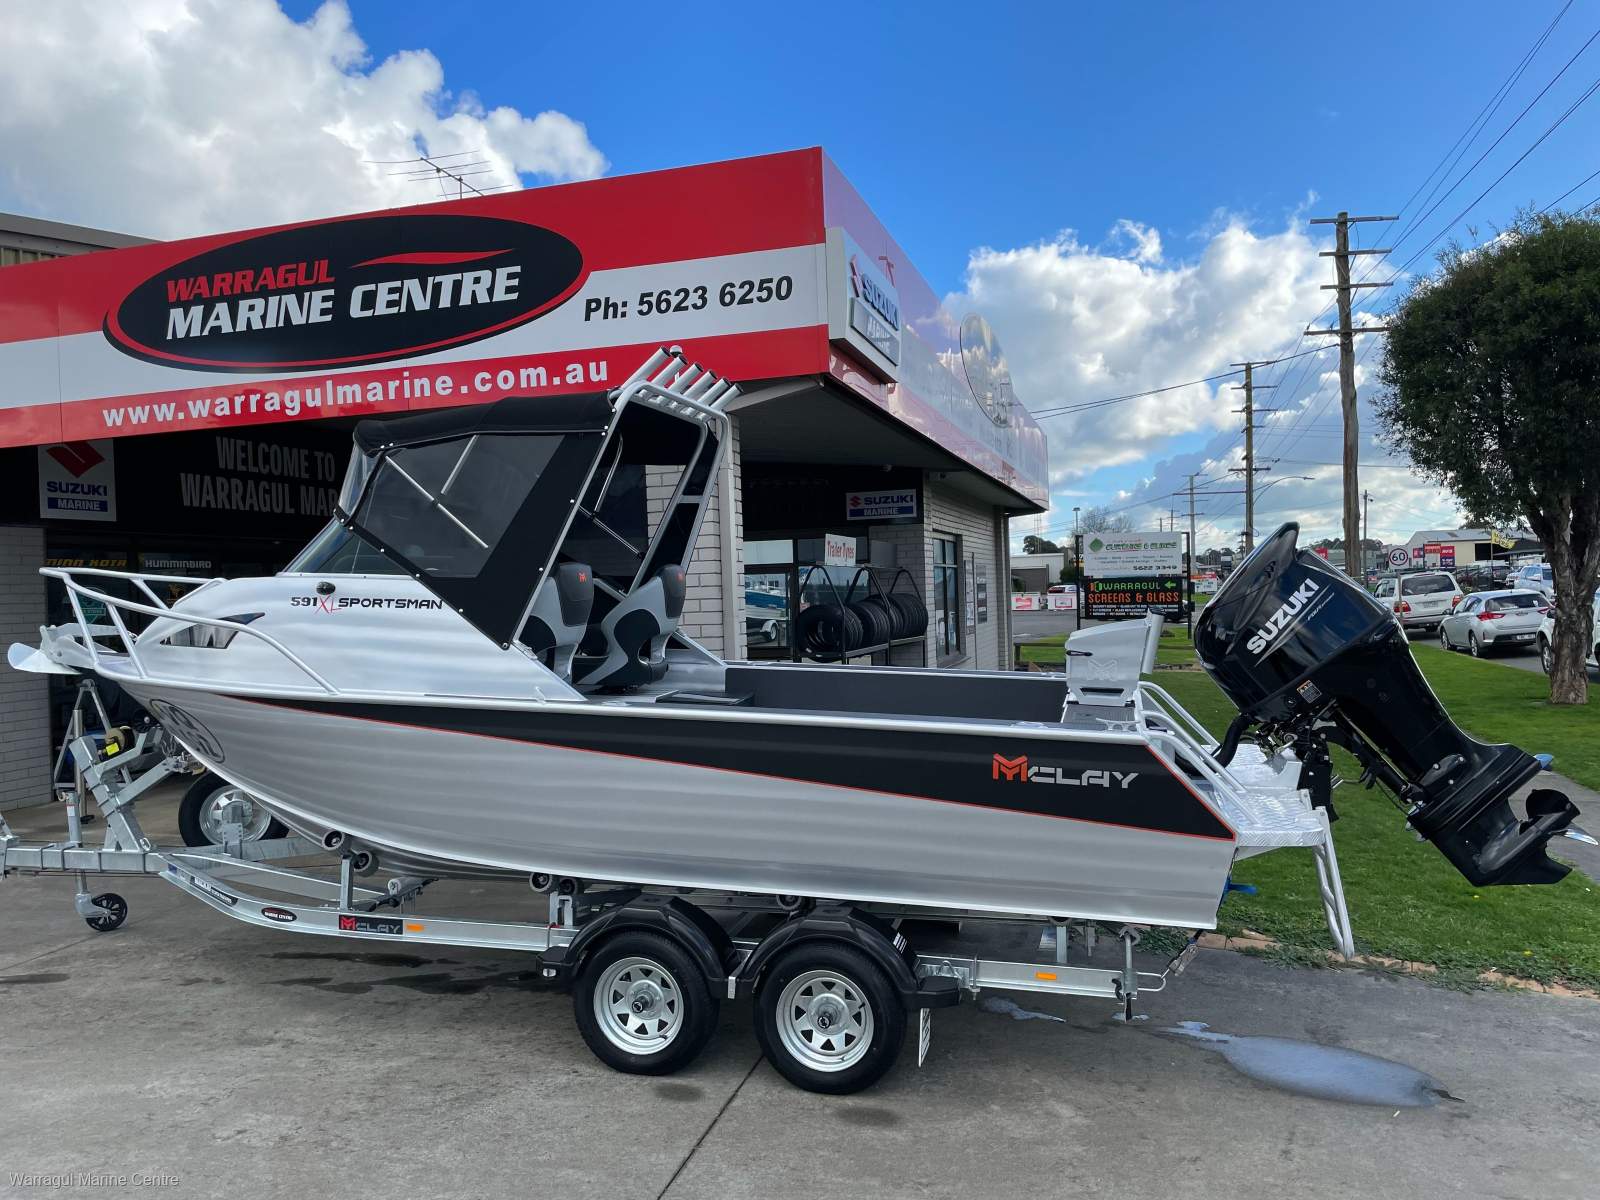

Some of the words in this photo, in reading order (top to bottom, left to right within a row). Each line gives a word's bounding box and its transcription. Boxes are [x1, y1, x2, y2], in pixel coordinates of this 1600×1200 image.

[166, 259, 336, 303] WARRAGUL
[166, 288, 335, 340] MARINE
[349, 265, 522, 319] CENTRE
[584, 296, 629, 322] Ph:
[636, 285, 708, 317] 5623
[718, 275, 794, 308] 6250
[860, 273, 899, 332] SUZUKI
[103, 360, 608, 427] www.warragulmarine.com.au
[215, 436, 310, 479] WELCOME
[314, 451, 337, 482] TO
[46, 480, 108, 497] SUZUKI
[179, 472, 296, 515] WARRAGUL
[57, 498, 101, 511] MARINE
[864, 494, 914, 506] SUZUKI
[864, 507, 899, 517] MARINE
[144, 560, 212, 569] HUMMINBIRD
[1391, 551, 1406, 562] 60
[1103, 581, 1161, 590] WARRAGUL
[290, 596, 318, 607] 591
[337, 597, 444, 610] SPORTSMAN
[1088, 592, 1131, 603] SCREENS
[1146, 591, 1179, 602] GLASS
[1246, 577, 1320, 655] SUZUKI
